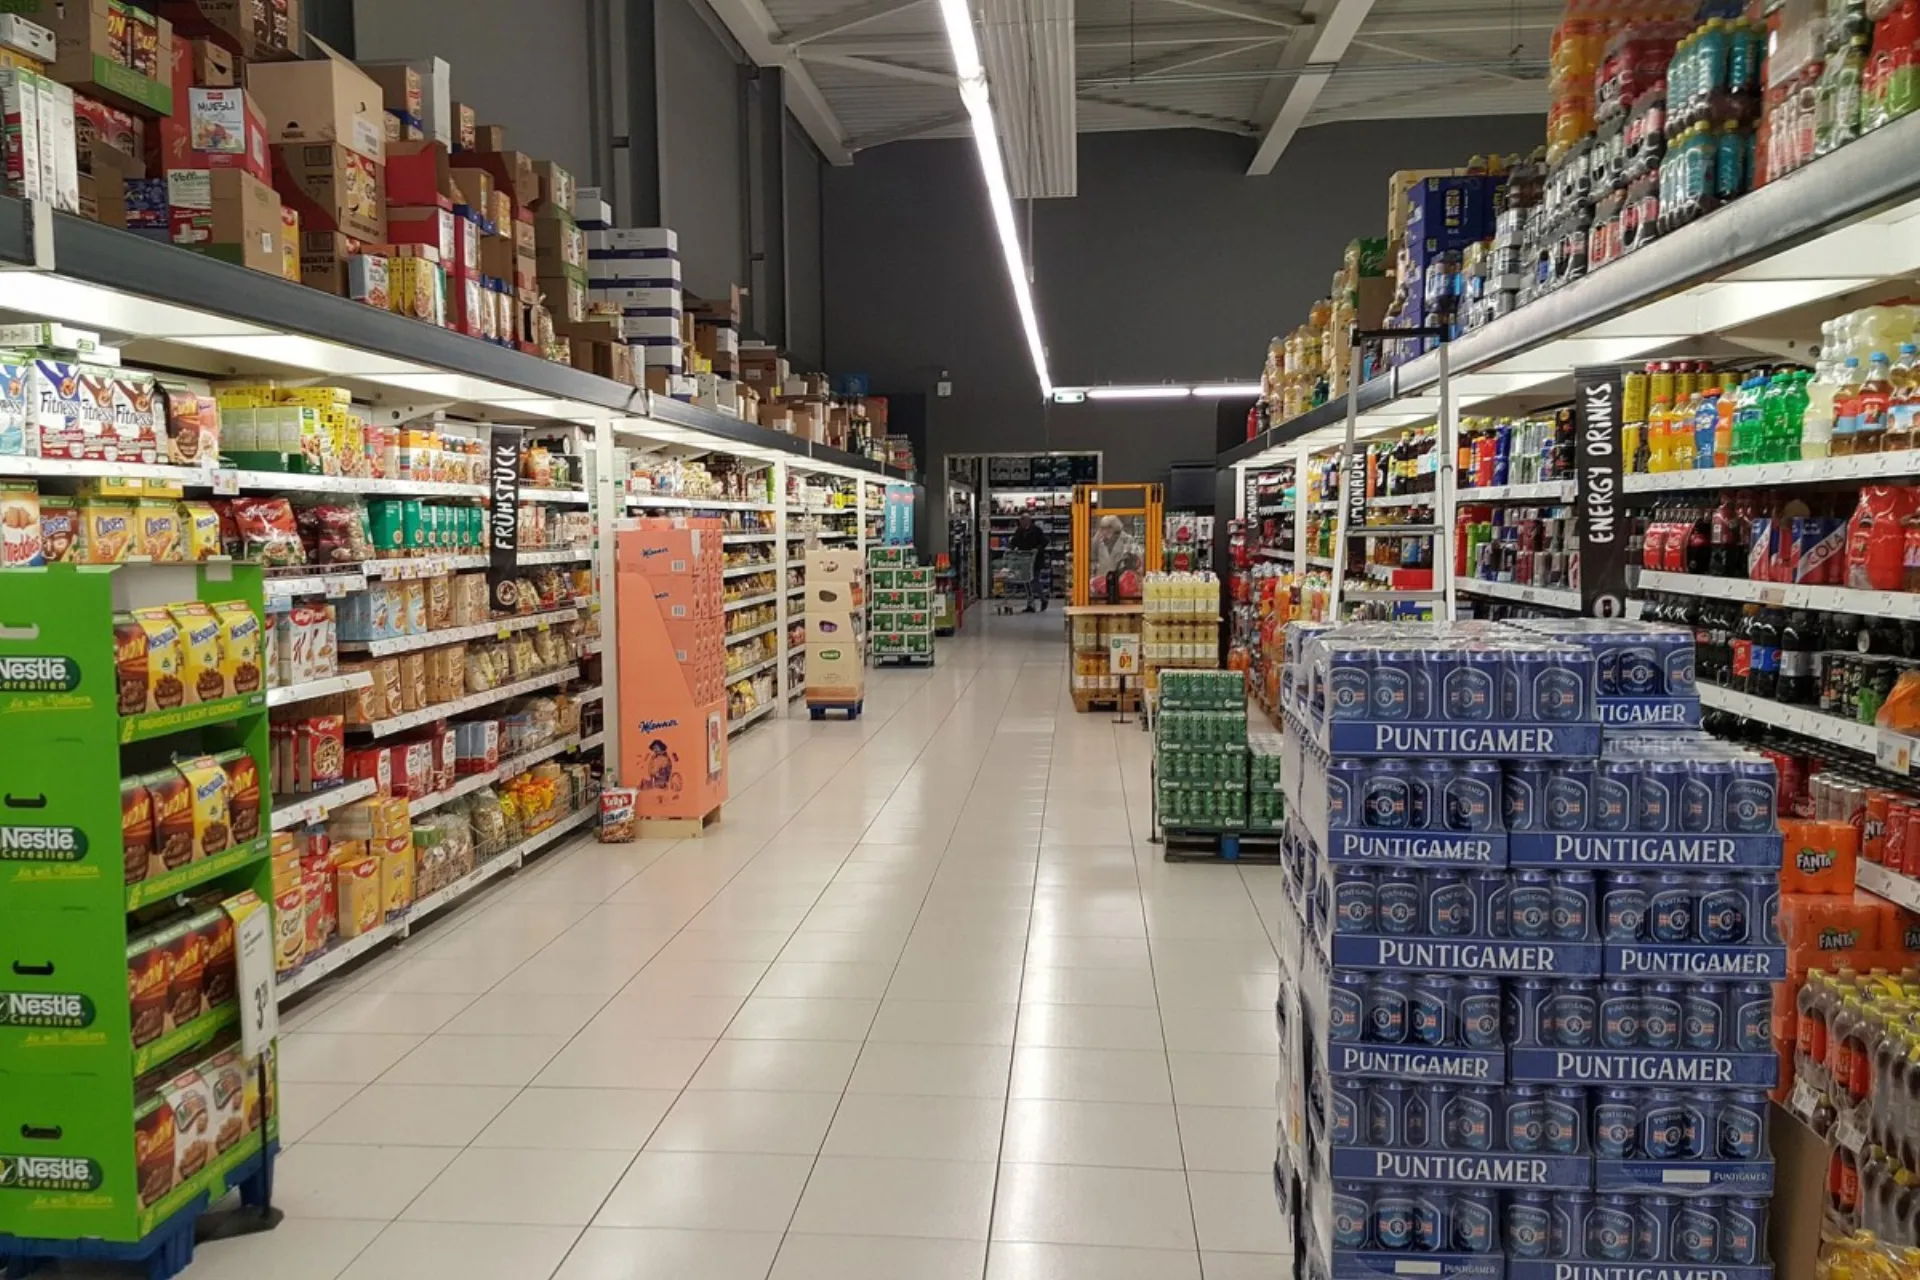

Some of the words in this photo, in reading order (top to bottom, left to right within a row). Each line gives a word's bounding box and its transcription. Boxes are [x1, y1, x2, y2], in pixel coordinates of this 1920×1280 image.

[197, 101, 236, 112] MUESLI
[40, 391, 80, 418] Fitness
[116, 404, 154, 426] Fitness
[492, 445, 517, 550] FRÜHSTÜCK
[1586, 466, 1615, 543] ENERGY
[1806, 532, 1844, 565] COLA
[0, 681, 66, 690] erealien
[1597, 703, 1686, 722] TIGAMER
[1376, 725, 1554, 753] PUNTIGAMER
[1343, 834, 1492, 861] PUNTIGAMER
[1555, 834, 1736, 863] PUNTIGAMER
[1796, 853, 1833, 869] FANTA
[1379, 939, 1555, 971] PUNTIGAMER
[1621, 949, 1770, 974] PUNTIGAMER
[1344, 1047, 1489, 1078] PUNTIGAMER
[1557, 1052, 1733, 1082] PUNTIGAMER
[1376, 1151, 1548, 1183] PUNTIGAMER
[1713, 1171, 1769, 1182] PUNTIGAMER
[1444, 1261, 1497, 1275] PUNTIGAMER
